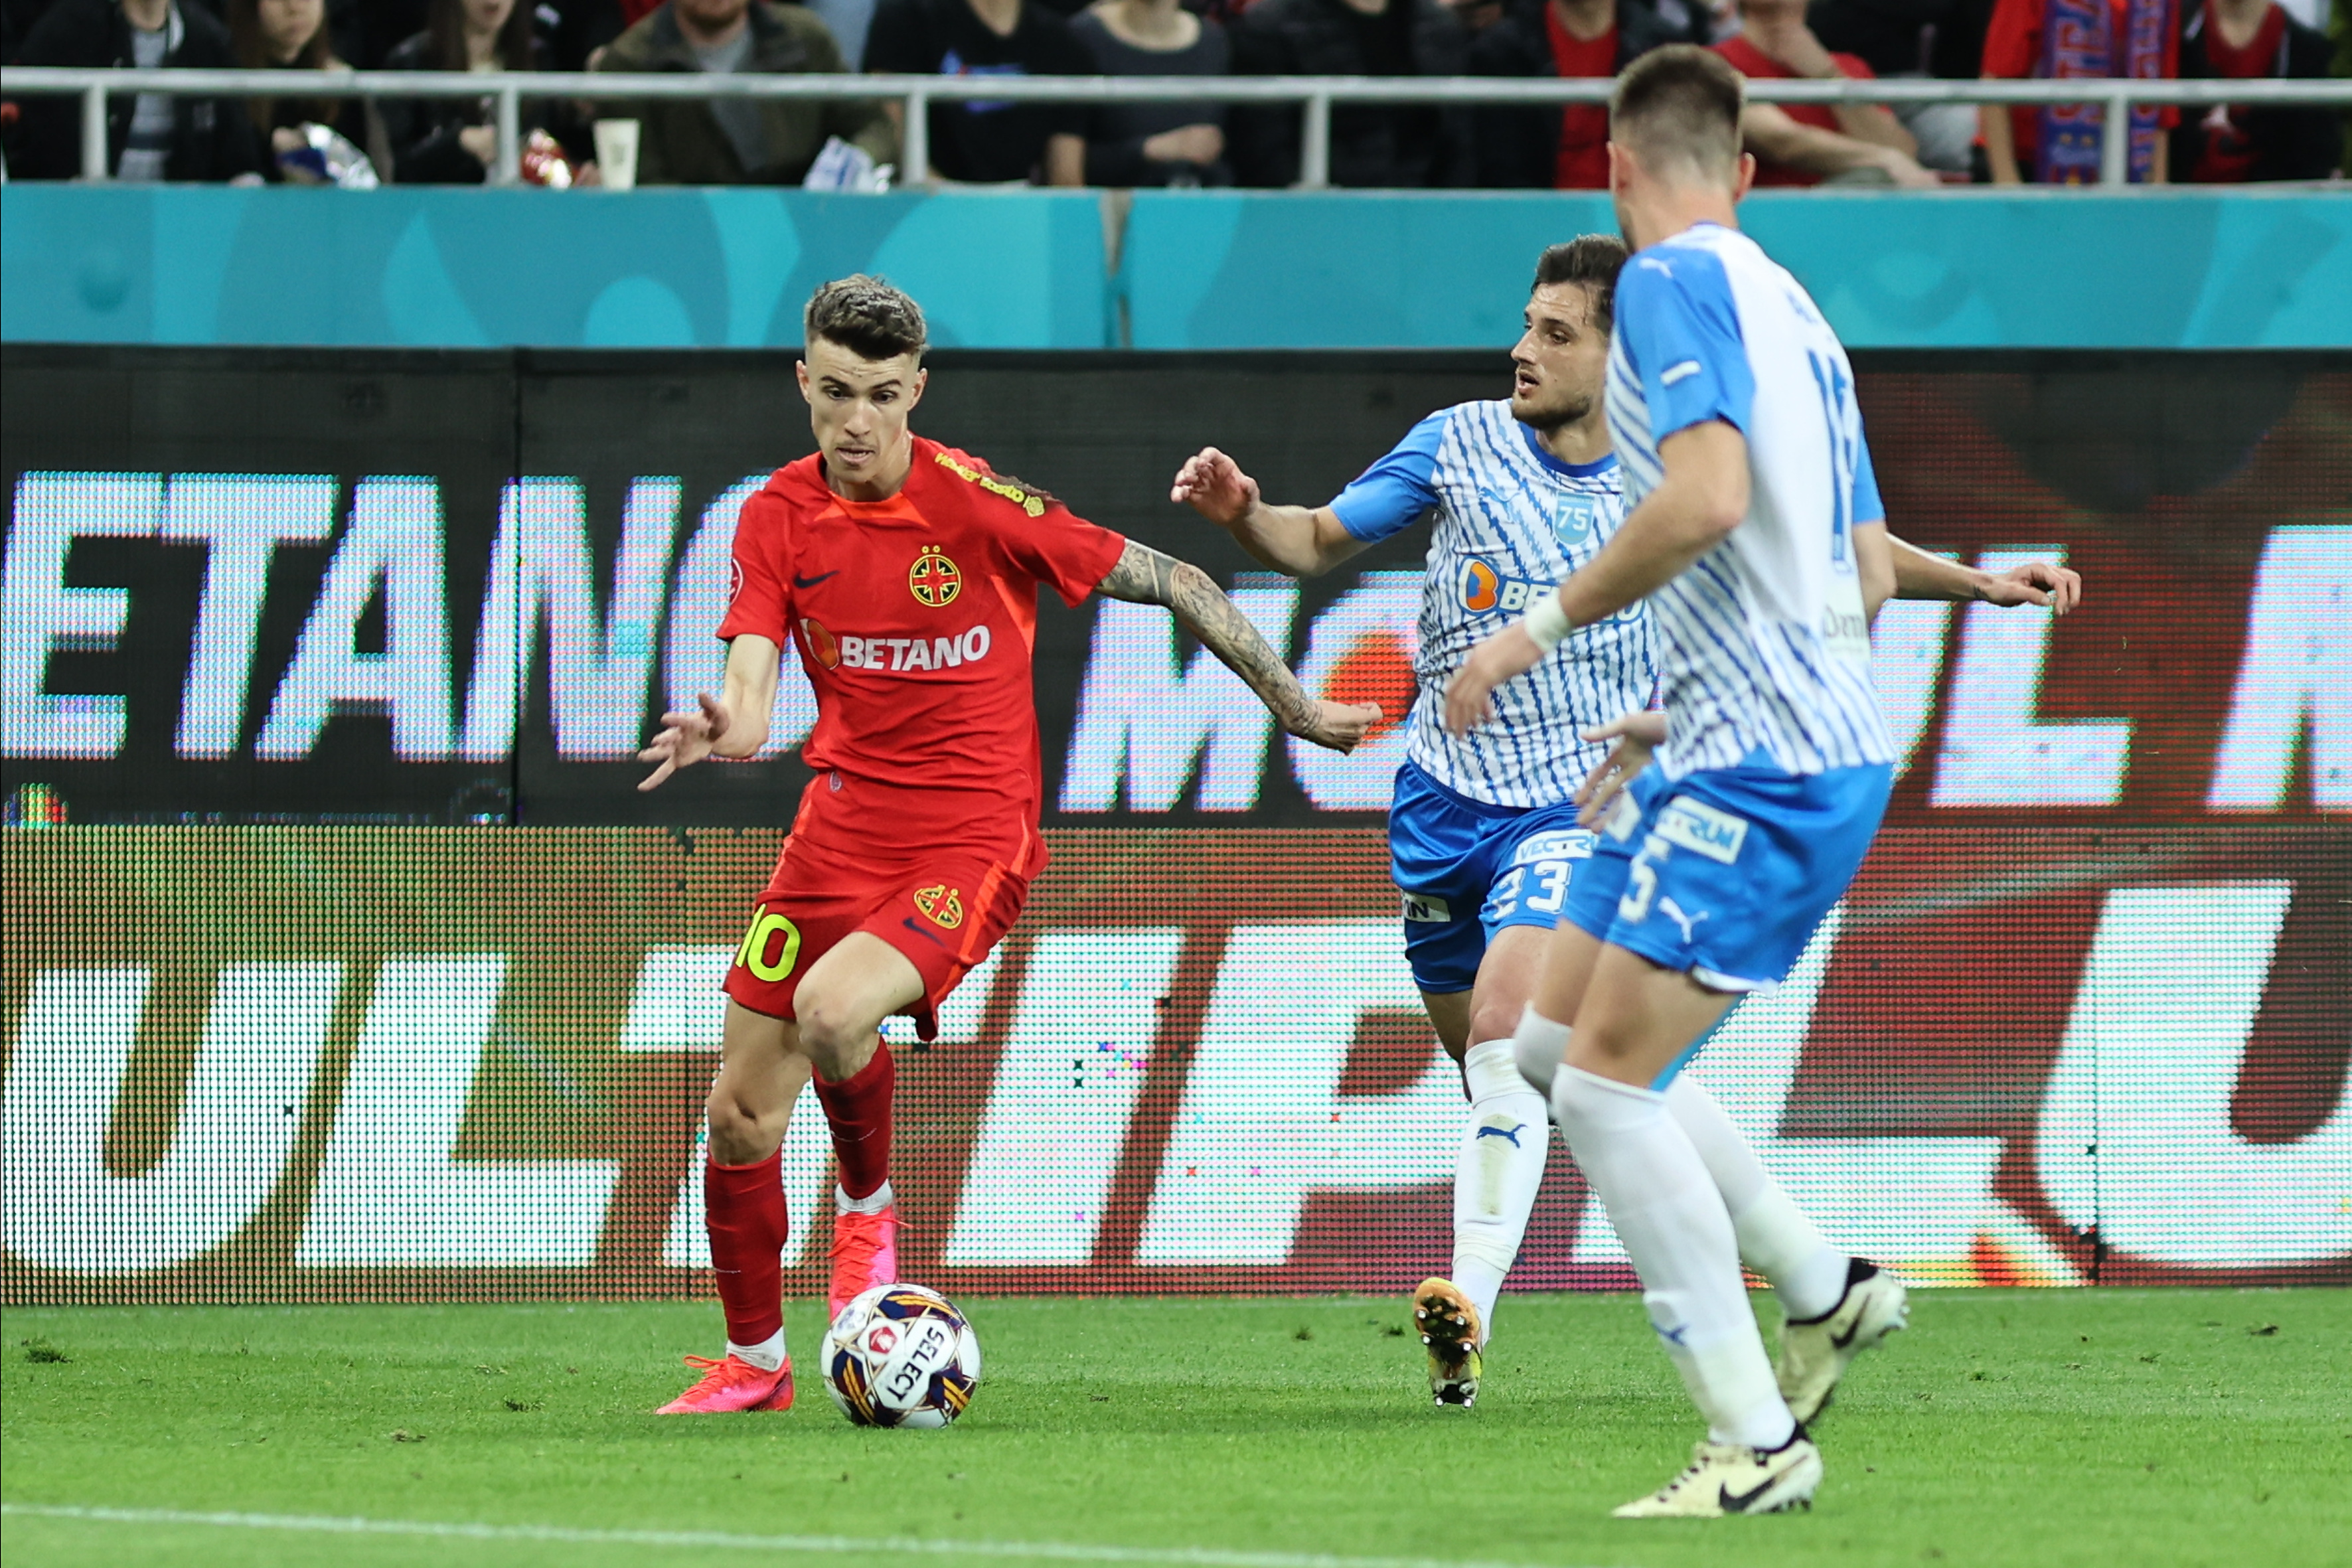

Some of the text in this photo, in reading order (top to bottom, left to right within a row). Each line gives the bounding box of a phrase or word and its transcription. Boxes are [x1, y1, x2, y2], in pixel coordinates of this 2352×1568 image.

[1557, 505, 1590, 532] 75
[841, 625, 991, 672] BETANO
[1489, 860, 1573, 920] 23
[735, 903, 801, 982] 10
[887, 1326, 945, 1403] SELECT
